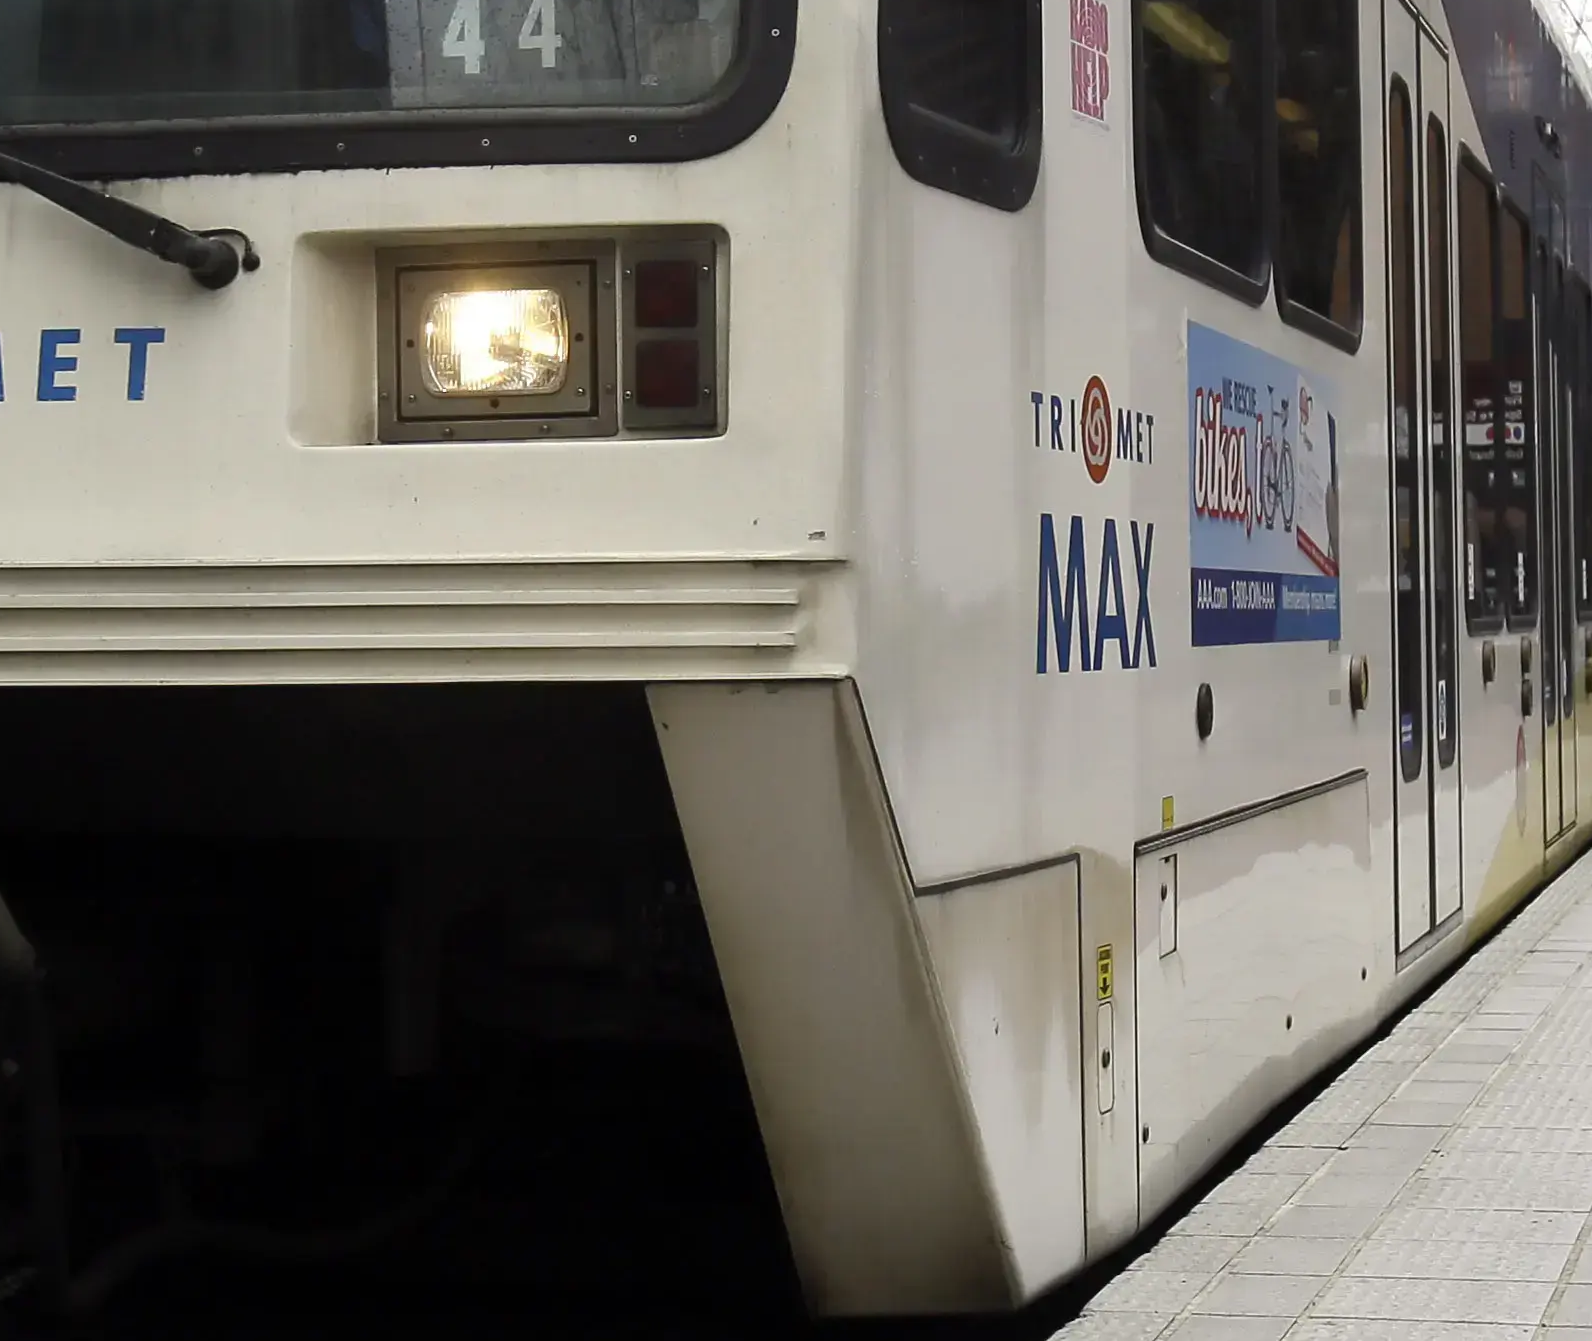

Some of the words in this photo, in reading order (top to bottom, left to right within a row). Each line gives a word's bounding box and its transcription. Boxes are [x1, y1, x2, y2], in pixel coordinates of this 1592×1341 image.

[1069, 40, 1111, 122] HELP
[1030, 390, 1077, 453] TRI
[1116, 407, 1155, 465] MET
[1194, 386, 1252, 538] bikes,
[1035, 513, 1157, 675] MAX
[1197, 578, 1228, 609] AAA.com
